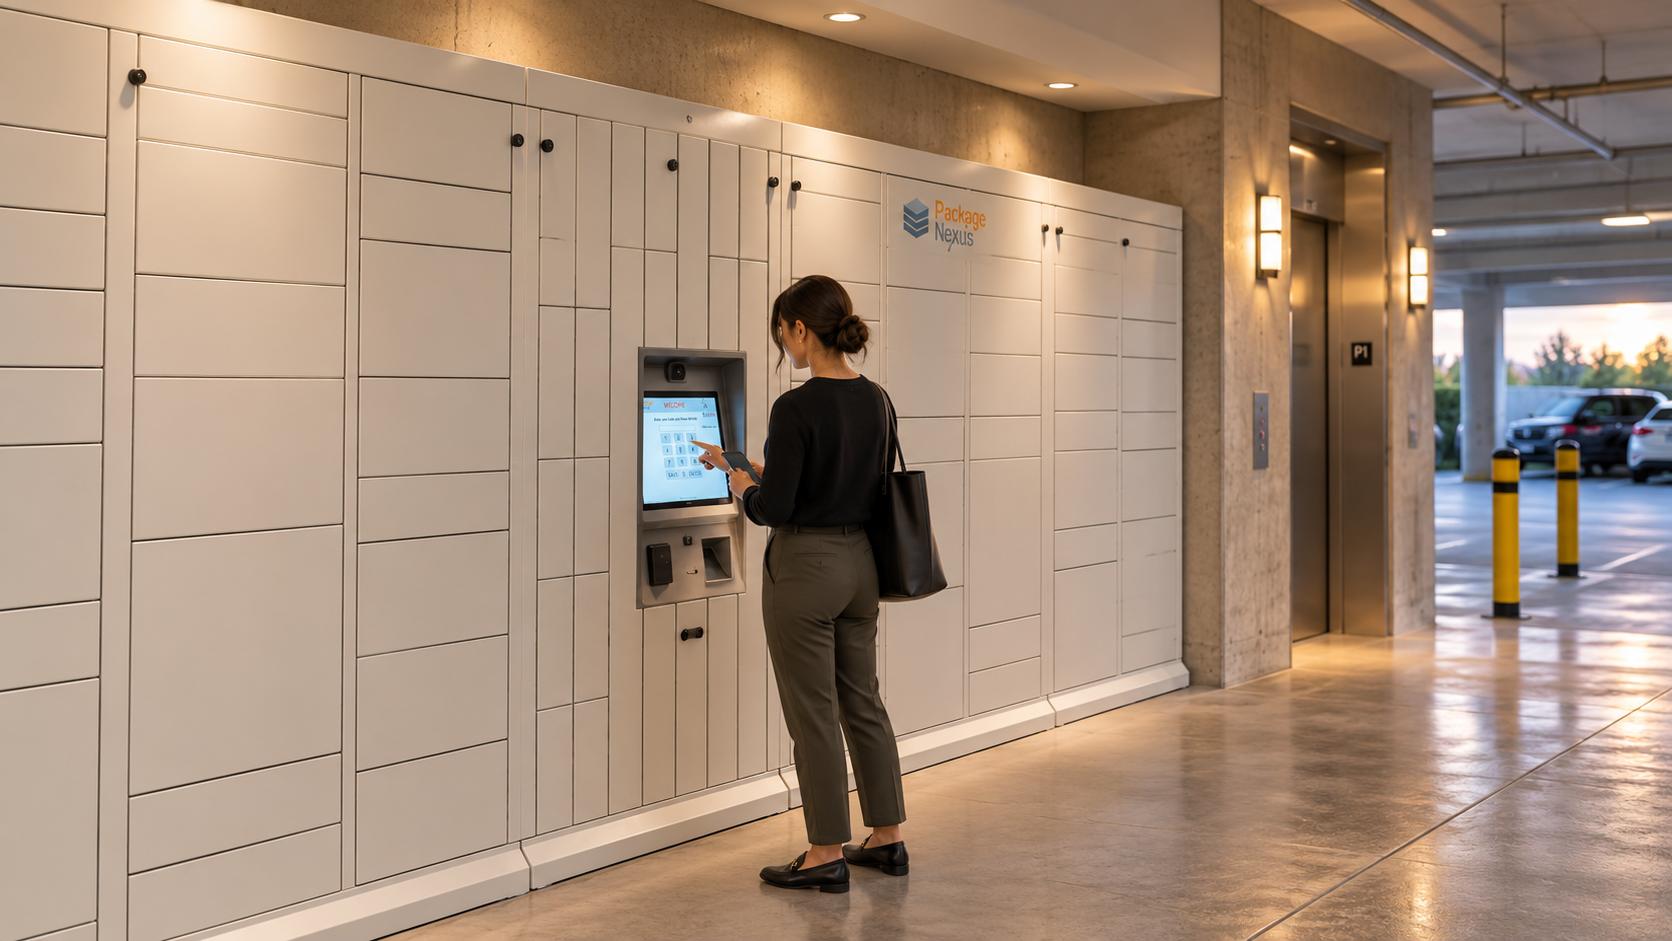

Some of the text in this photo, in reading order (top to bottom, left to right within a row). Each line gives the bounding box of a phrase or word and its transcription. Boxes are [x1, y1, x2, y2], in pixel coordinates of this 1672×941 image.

[935, 200, 986, 231] Package
[935, 222, 974, 251] Nexus
[1354, 345, 1368, 358] P1
